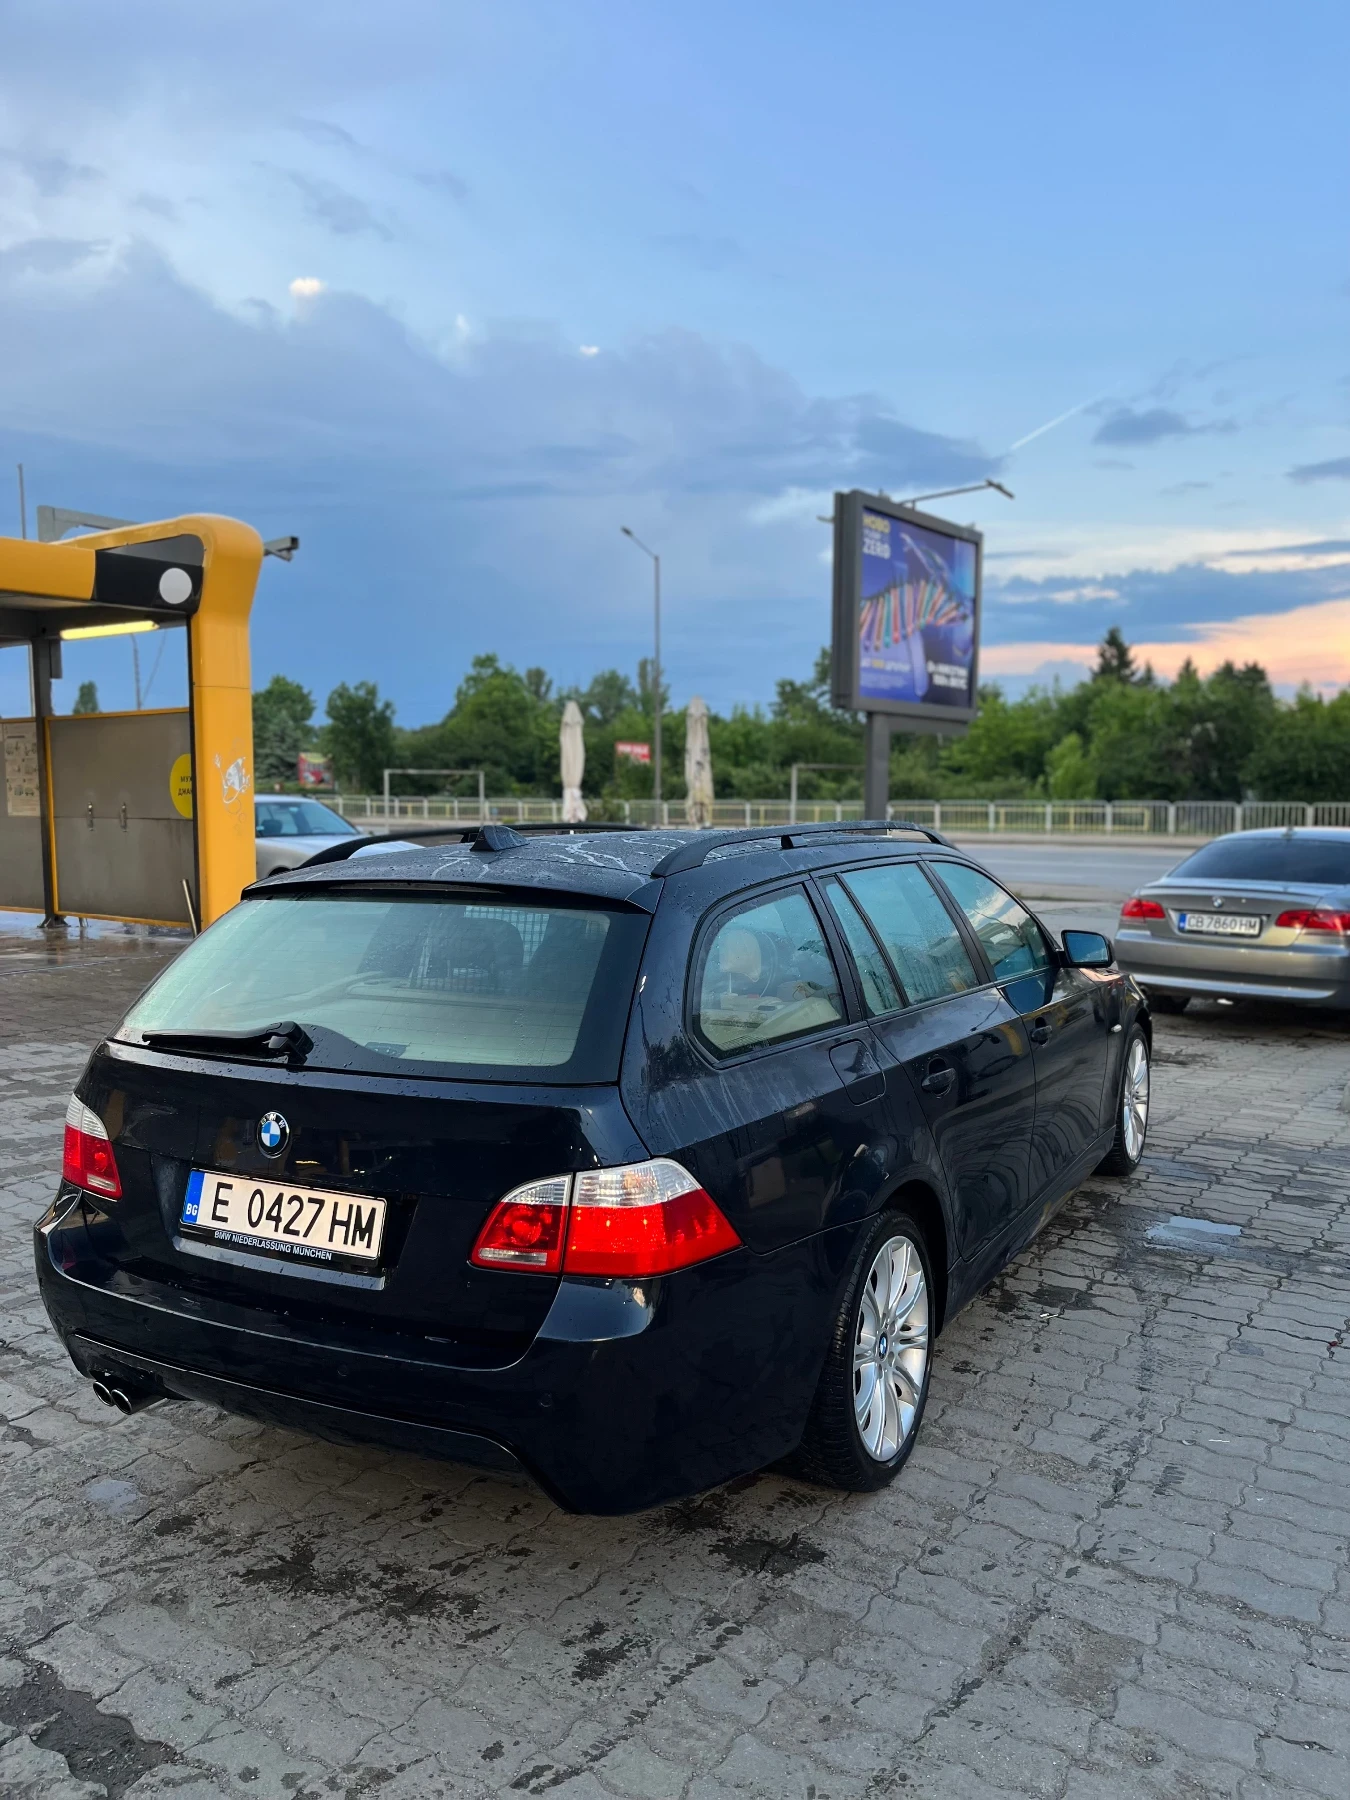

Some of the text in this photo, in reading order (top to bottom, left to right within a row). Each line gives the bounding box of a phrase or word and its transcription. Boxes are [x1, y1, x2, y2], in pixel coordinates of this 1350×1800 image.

[862, 538, 891, 560] ZERO
[1187, 915, 1204, 928] CB
[1205, 916, 1236, 930] 7860
[1239, 920, 1257, 932] HM
[260, 1112, 286, 1129] BMW
[186, 1202, 198, 1216] BG
[211, 1181, 377, 1249] E 0427 HM
[214, 1230, 232, 1241] BMW
[232, 1233, 291, 1253] NIEDERLASSUNG
